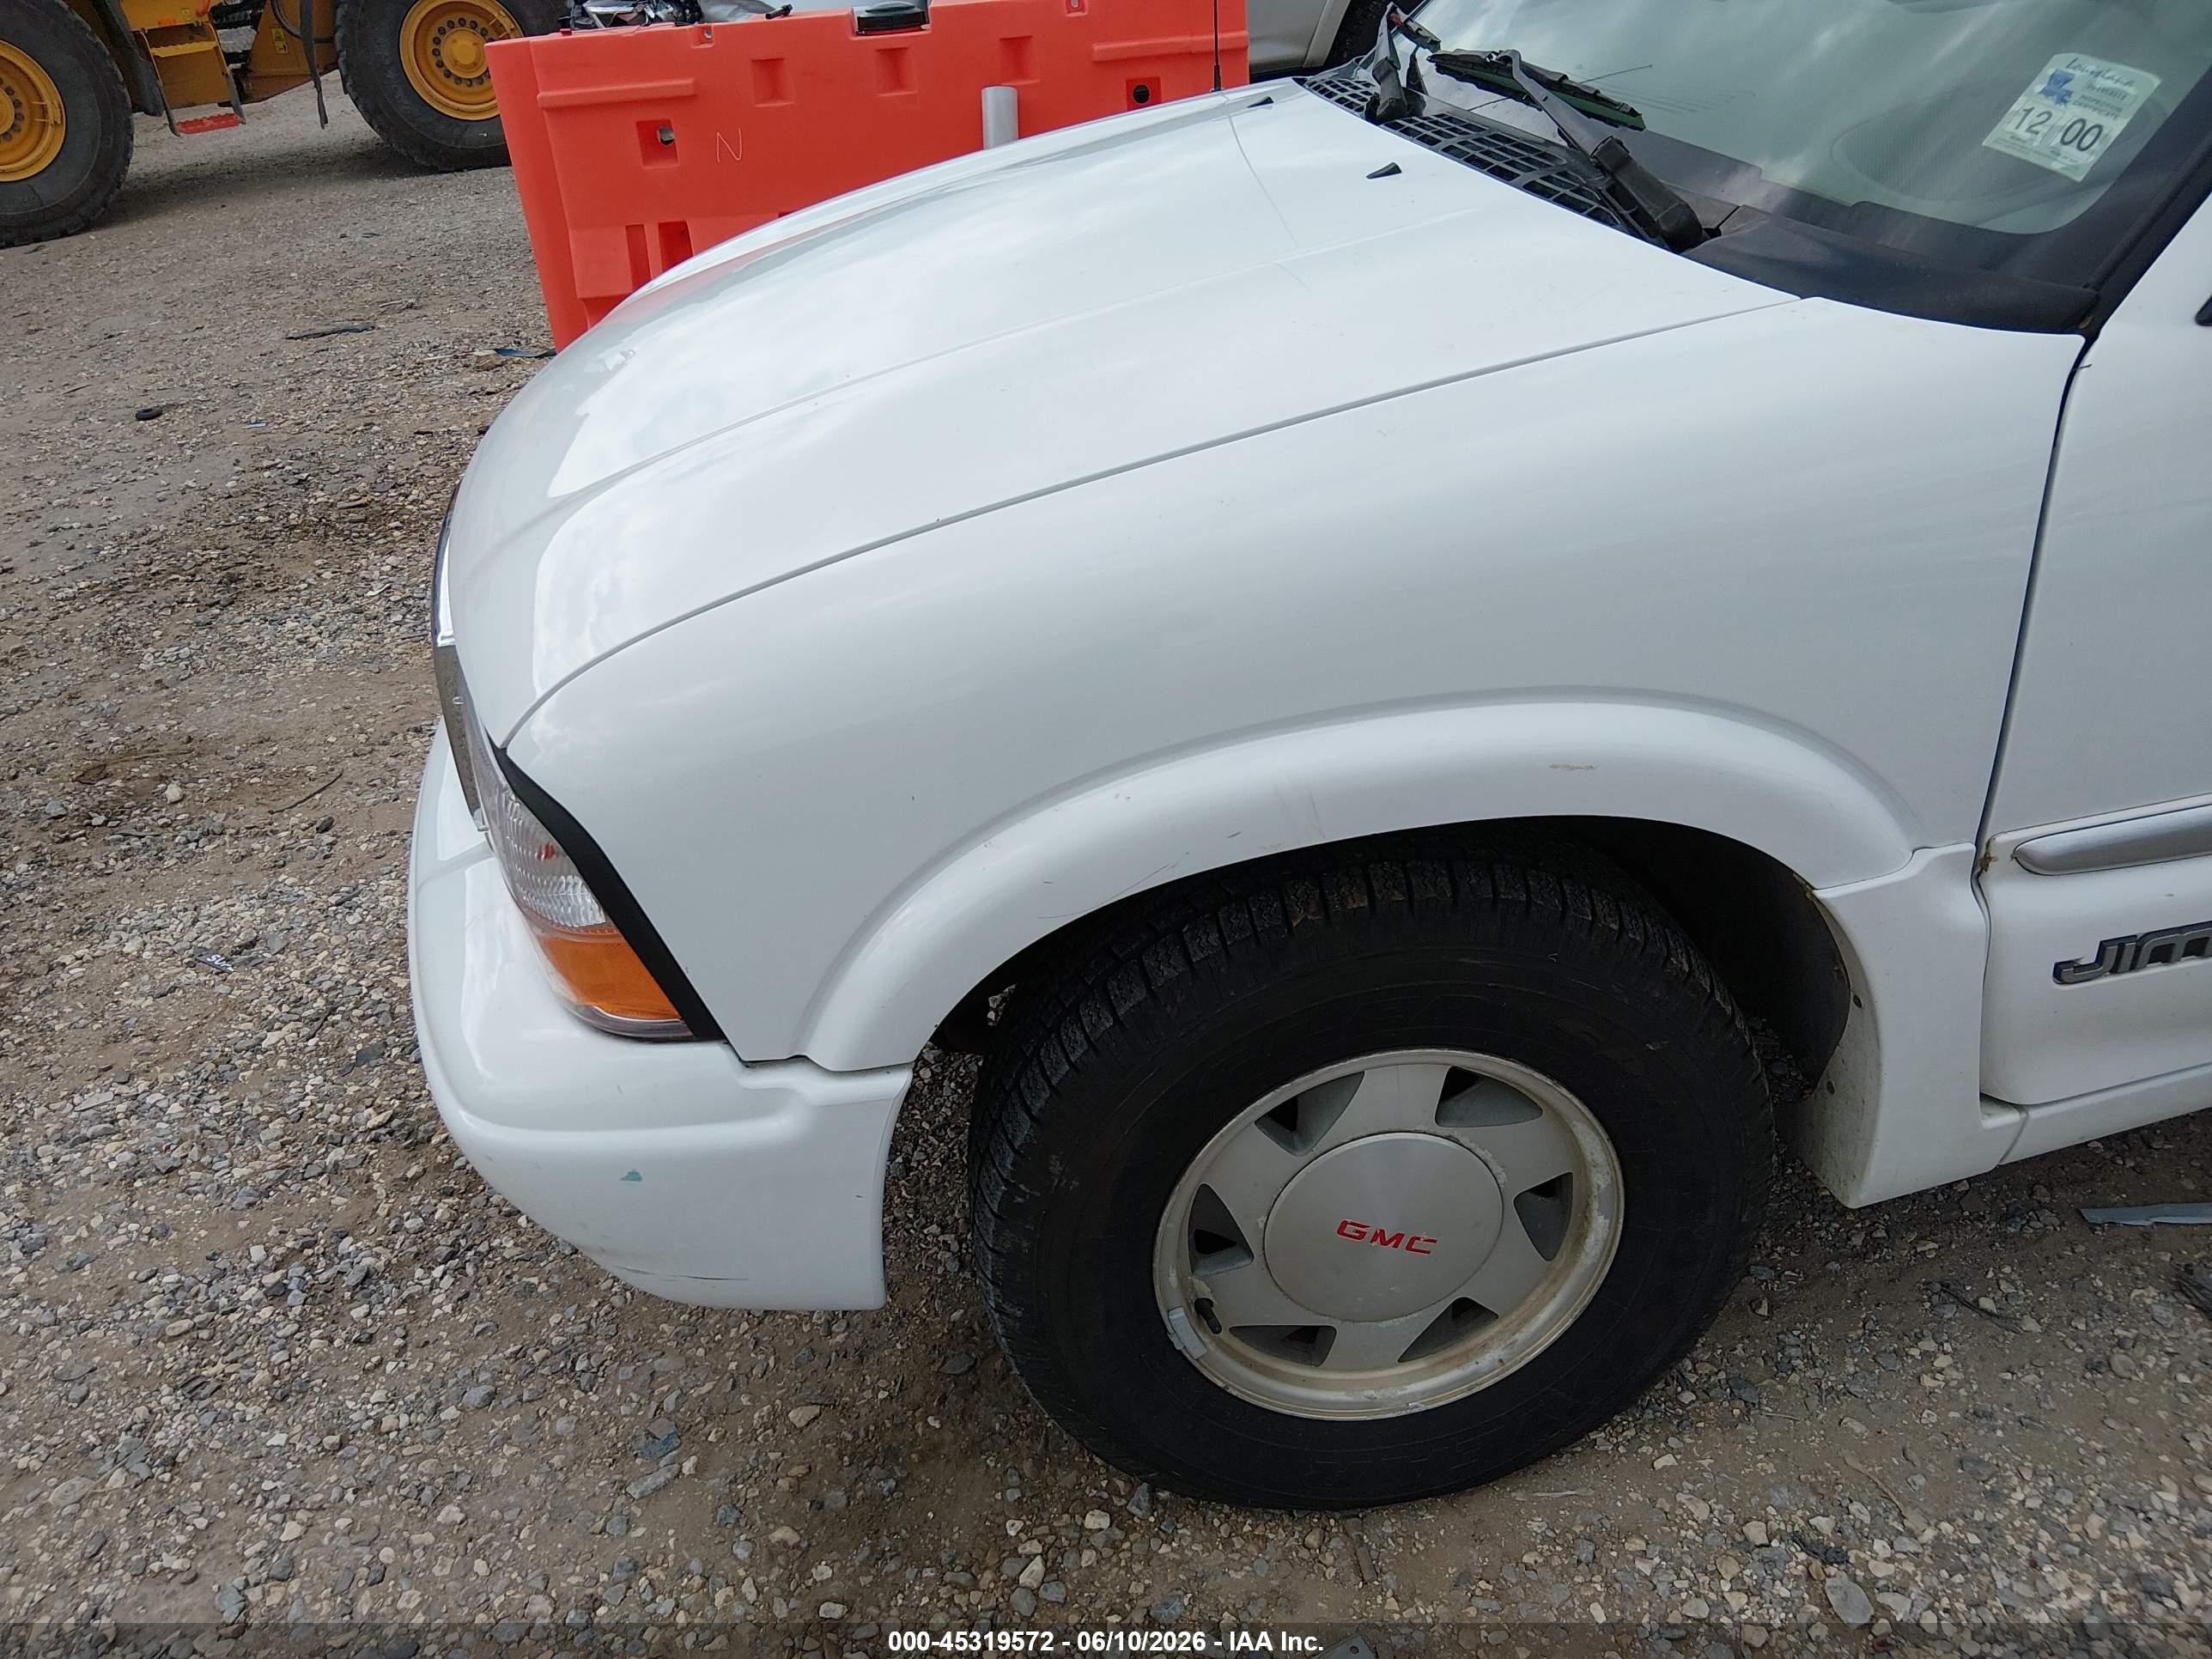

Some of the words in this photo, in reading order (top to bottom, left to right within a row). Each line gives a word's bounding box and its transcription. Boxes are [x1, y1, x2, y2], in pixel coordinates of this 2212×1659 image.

[2014, 106, 2053, 136] 12
[2059, 118, 2104, 152] 00
[1336, 1219, 1438, 1255] GMC
